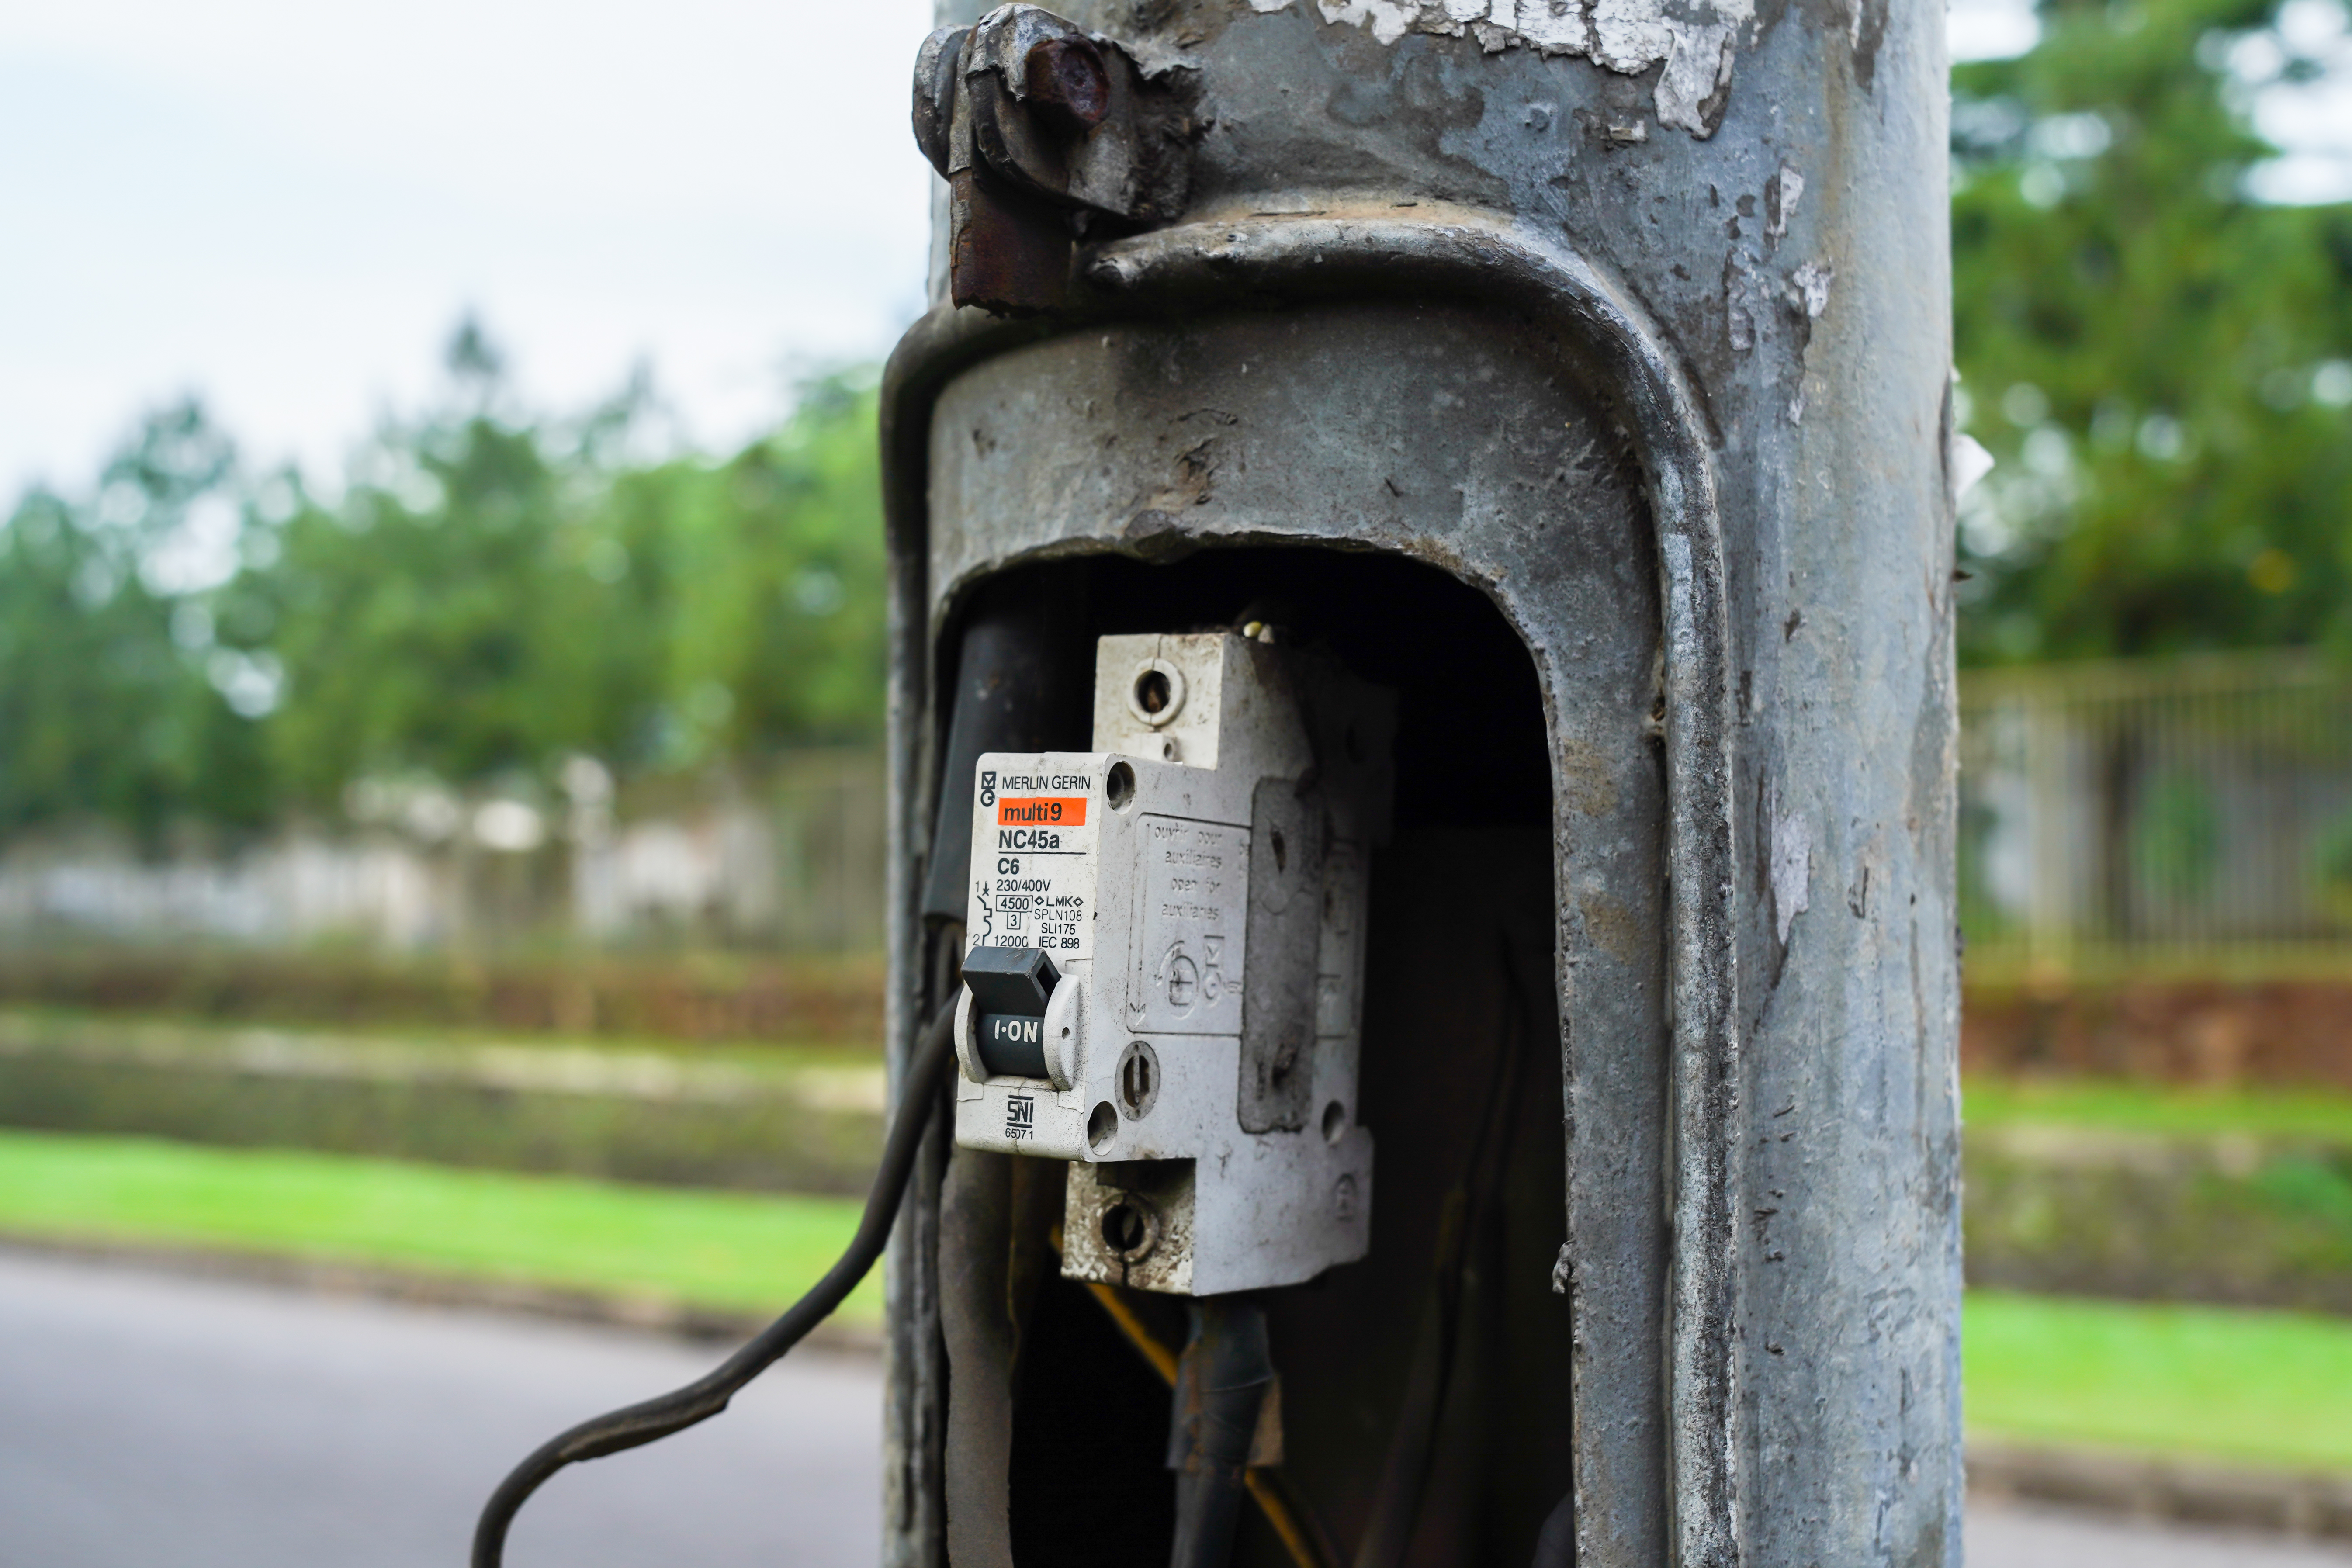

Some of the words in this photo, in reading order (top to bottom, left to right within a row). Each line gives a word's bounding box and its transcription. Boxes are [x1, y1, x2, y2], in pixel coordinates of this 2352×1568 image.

[1002, 776, 1048, 789] MERLIN
[1052, 775, 1090, 789] GERIN
[999, 830, 1060, 848] NC45a
[998, 858, 1020, 874] C6
[996, 879, 1051, 892] 230/400V
[1001, 897, 1029, 910] 4500
[1010, 914, 1017, 926] 3
[1034, 909, 1082, 921] SPLN108
[1039, 936, 1056, 948] IEC
[1061, 937, 1080, 949] 898
[1007, 1100, 1033, 1123] SNI
